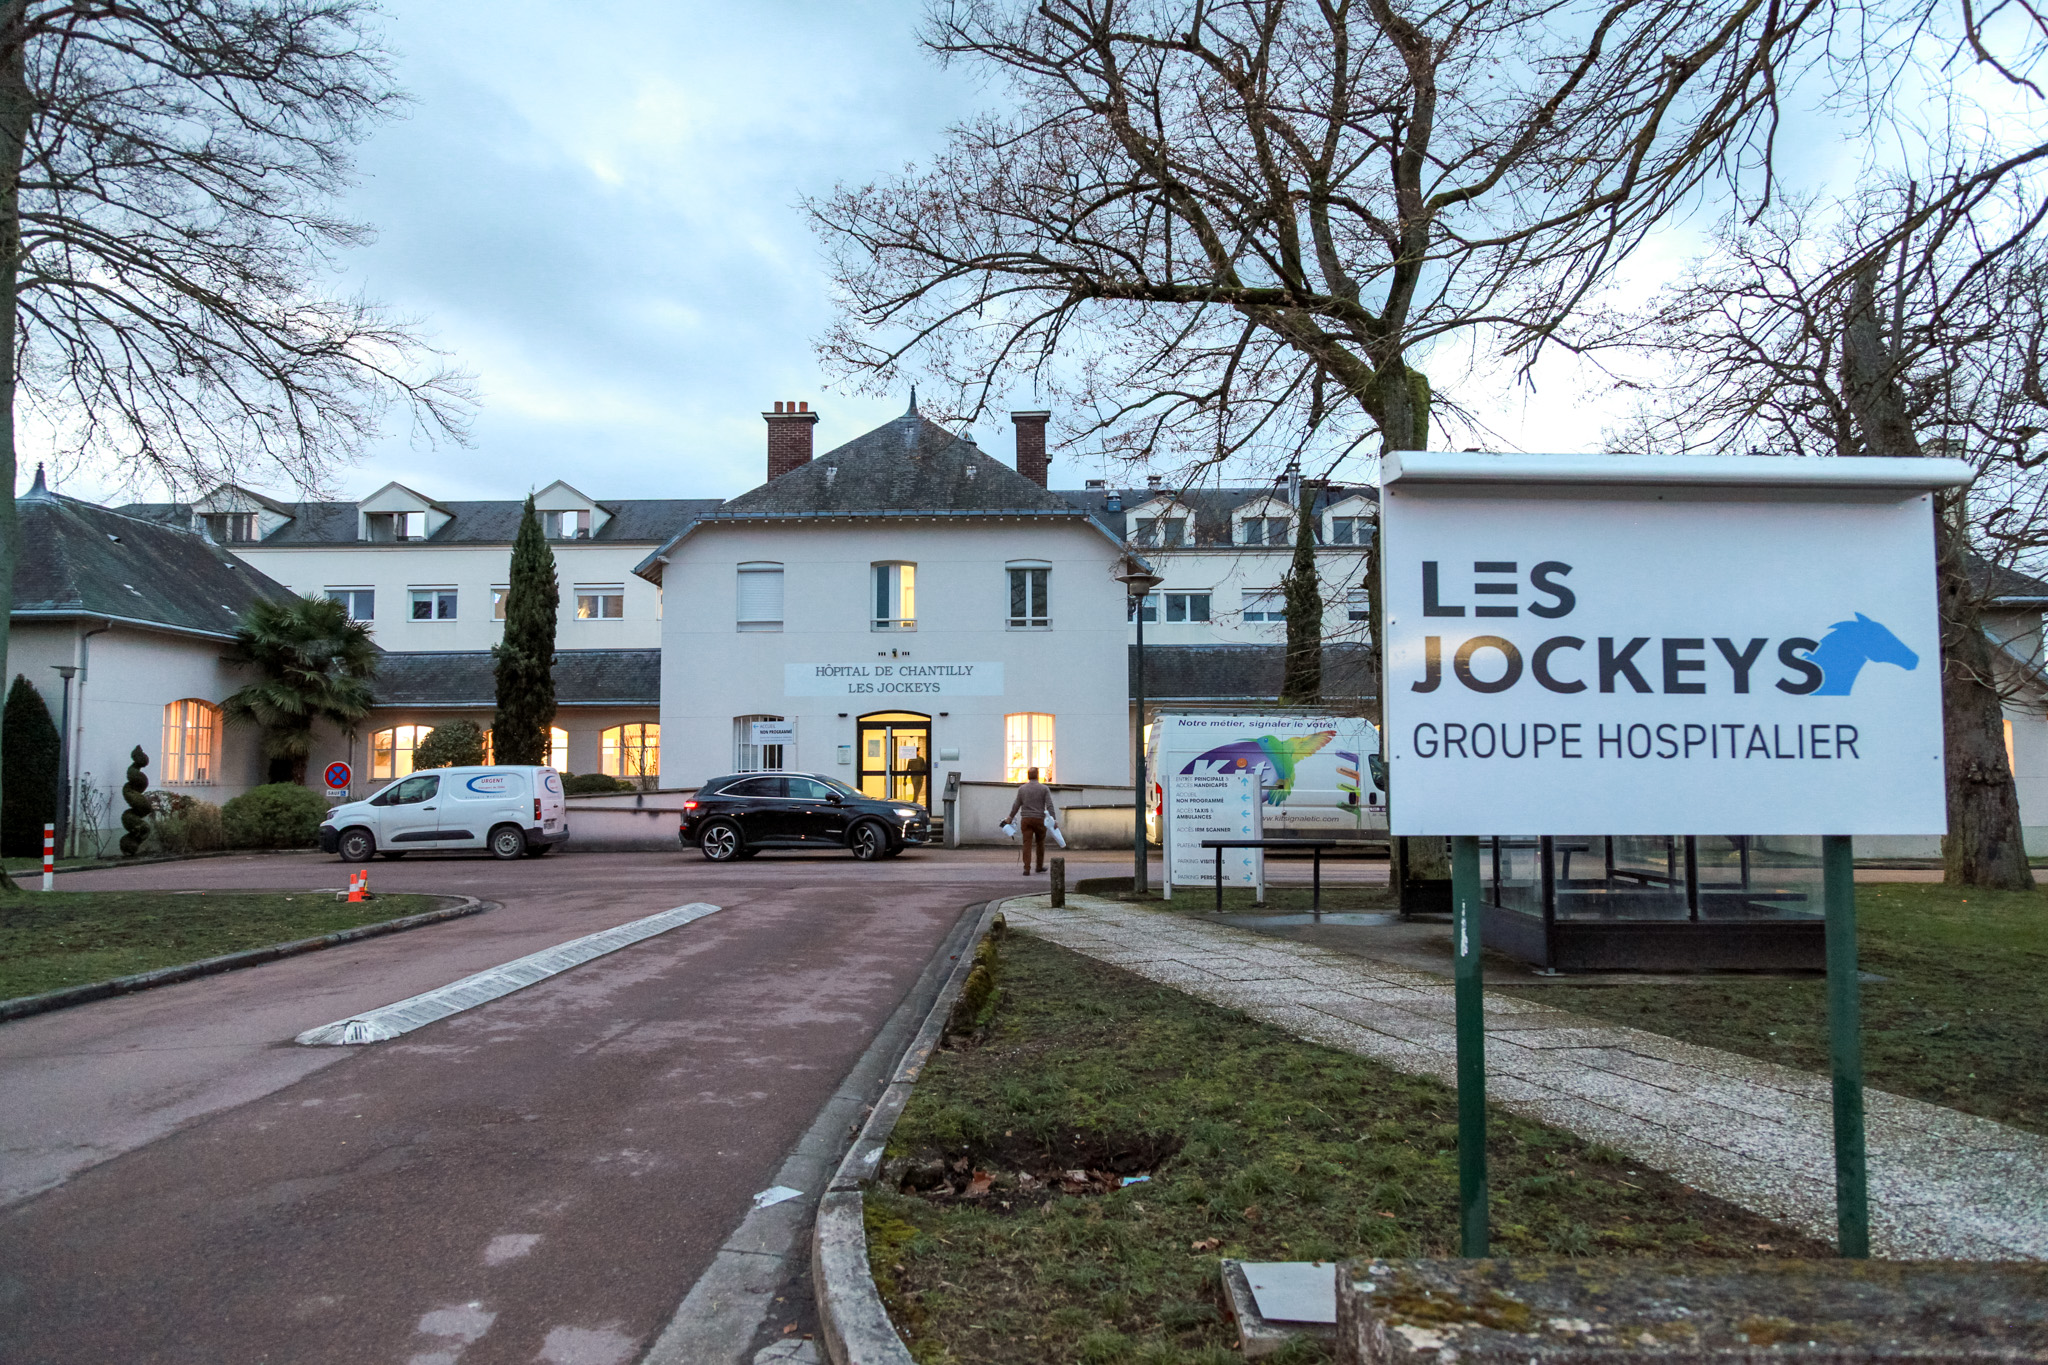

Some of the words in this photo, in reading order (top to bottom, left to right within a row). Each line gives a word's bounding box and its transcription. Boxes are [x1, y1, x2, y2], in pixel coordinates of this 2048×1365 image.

[1421, 560, 1577, 619] LES
[815, 664, 870, 677] HÔPITAL
[875, 666, 893, 676] DE
[899, 665, 974, 676] CHANTILLY
[1410, 635, 1824, 696] JOCKEYS
[848, 683, 874, 693] LES
[877, 682, 940, 693] JOCKEYS
[1178, 719, 1207, 727] Notre
[1249, 720, 1291, 729] signaler
[1294, 720, 1303, 728] le
[1413, 722, 1582, 759] GROUPE
[1599, 723, 1860, 759] HOSPITALIER
[1262, 815, 1339, 824] w.kitsignaletic.com
